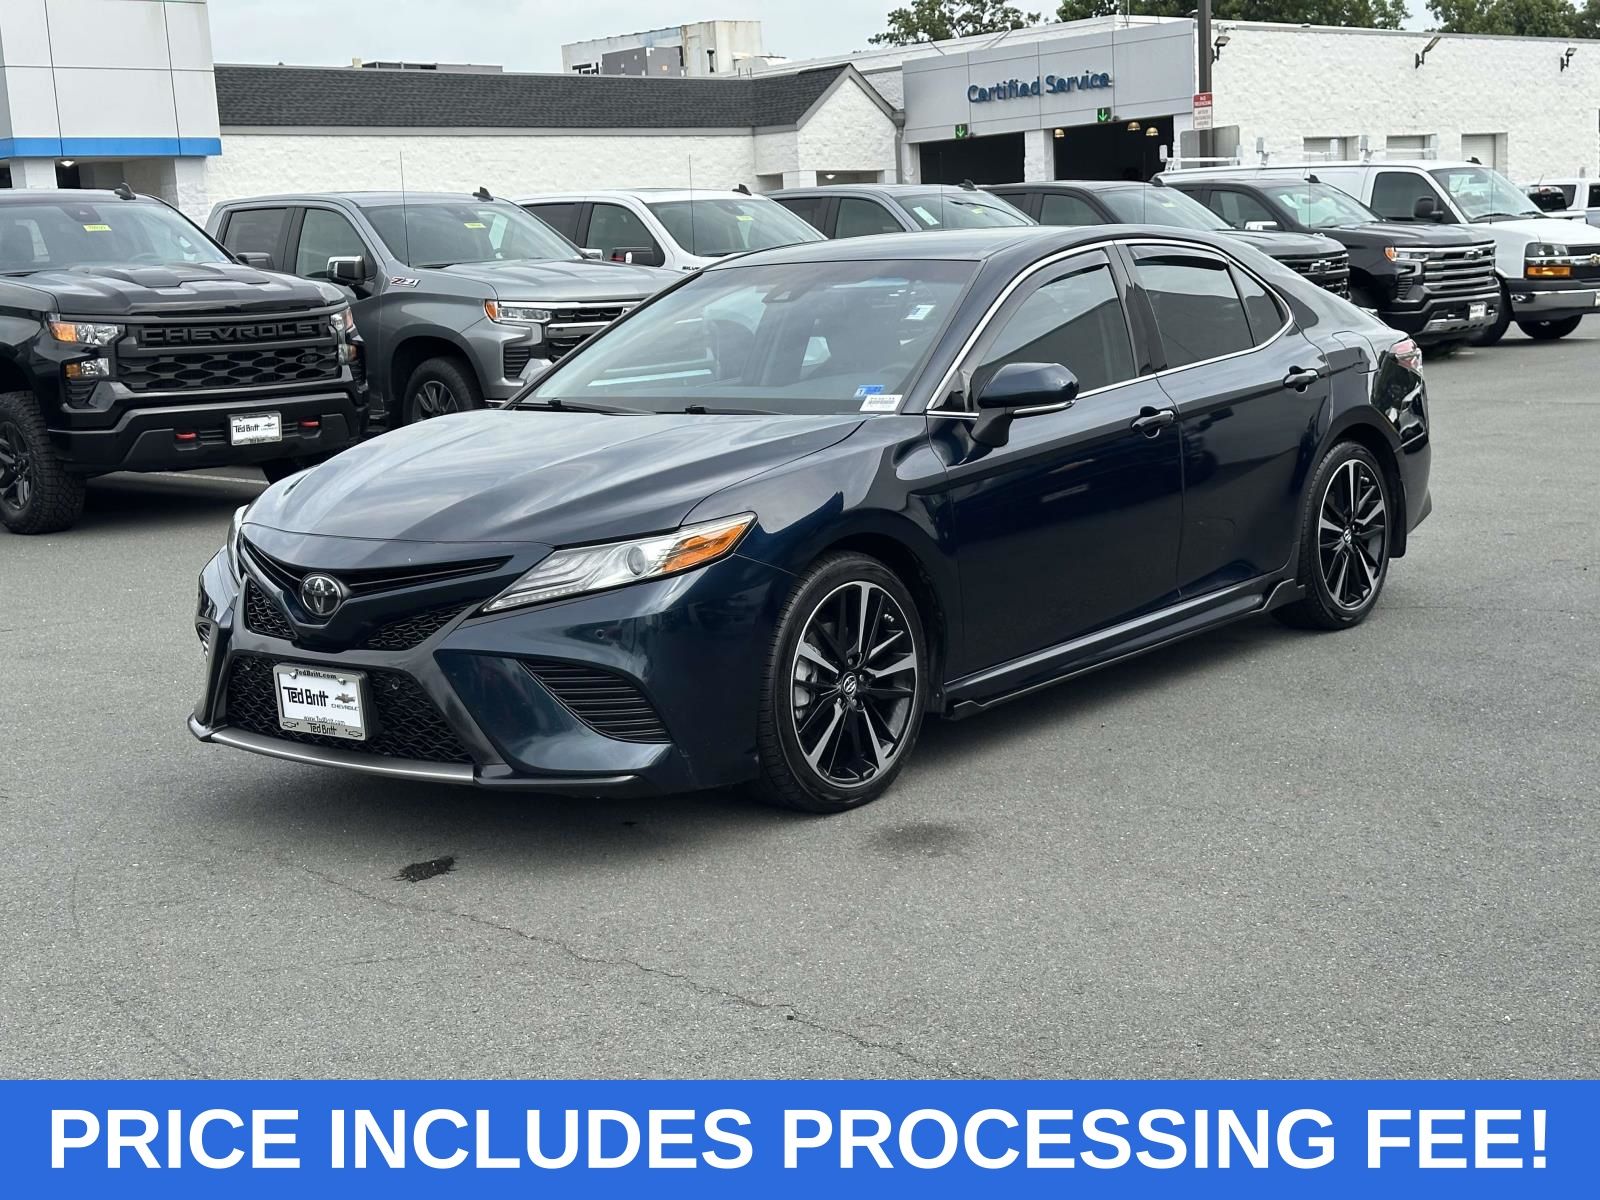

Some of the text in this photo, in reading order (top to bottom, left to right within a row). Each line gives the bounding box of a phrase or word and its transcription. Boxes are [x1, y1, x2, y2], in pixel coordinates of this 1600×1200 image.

[967, 70, 1110, 103] Certified Service
[141, 319, 328, 344] CHEVROLET
[282, 686, 329, 707] Ted Britt
[307, 722, 337, 736] Ted Britt
